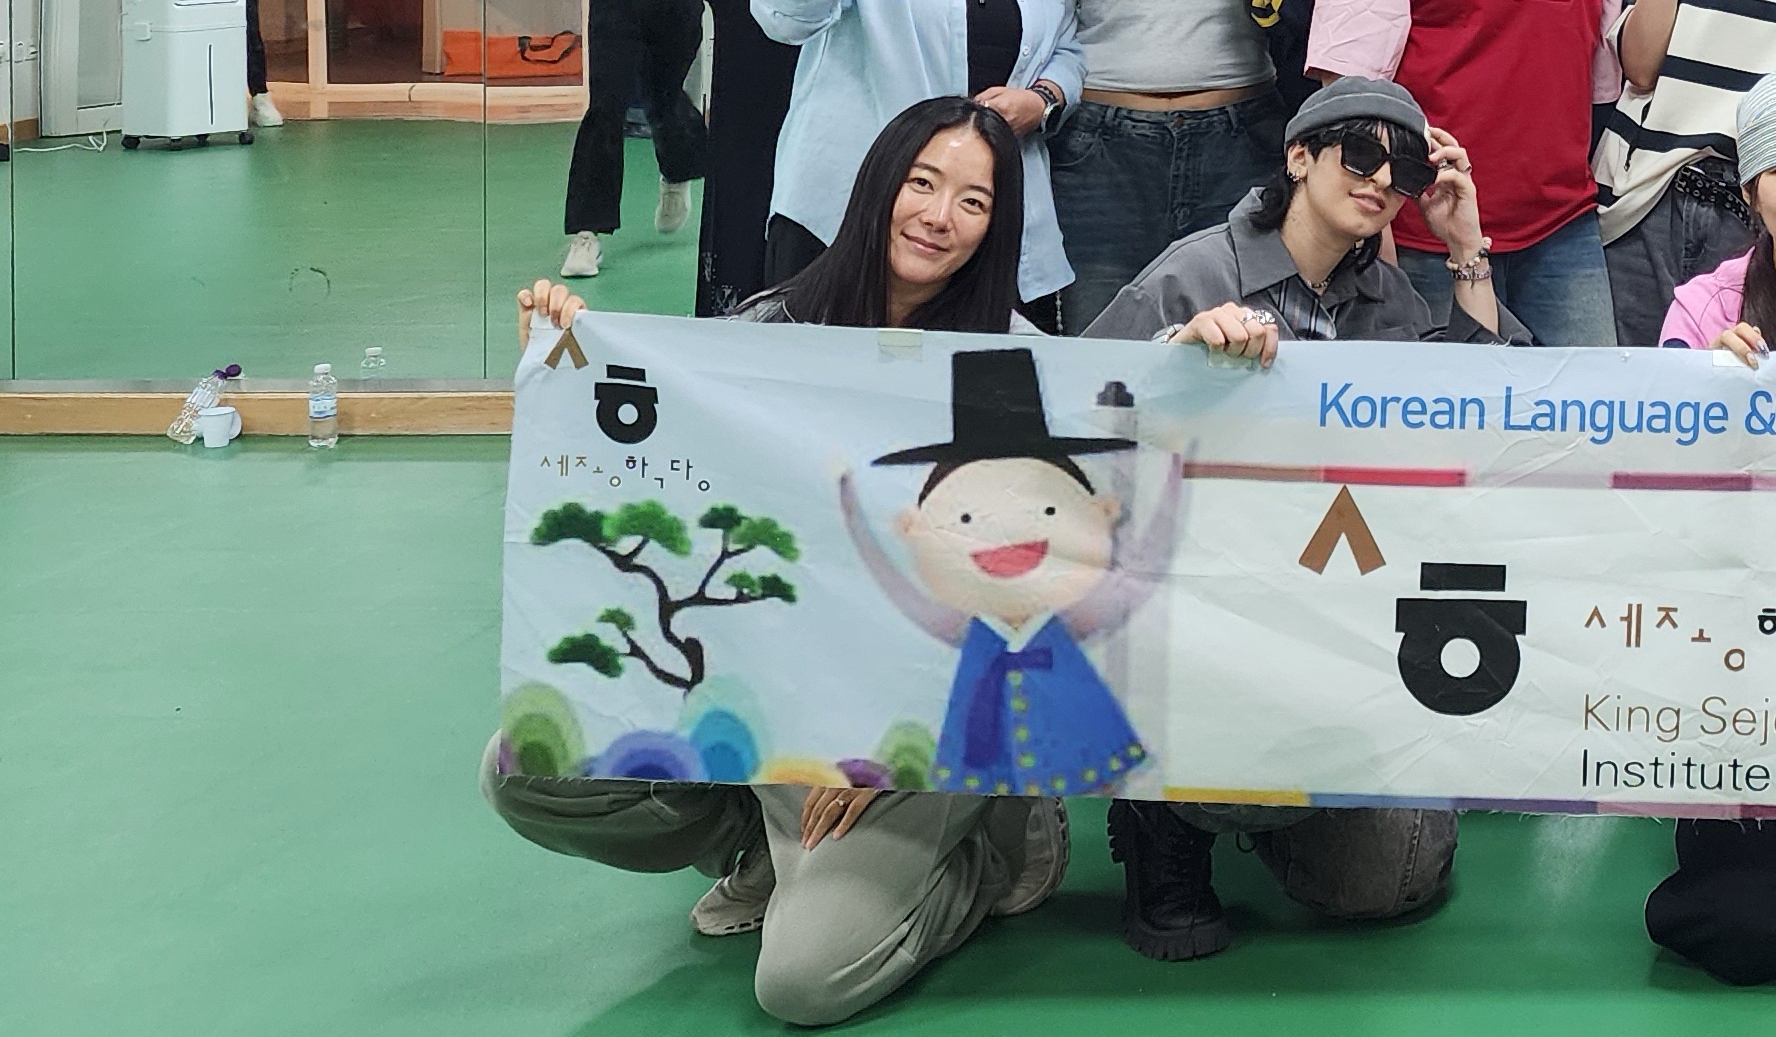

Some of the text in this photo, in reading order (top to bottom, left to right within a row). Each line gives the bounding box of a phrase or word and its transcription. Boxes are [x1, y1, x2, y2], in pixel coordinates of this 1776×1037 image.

[1318, 382, 1486, 432] Korean
[1503, 385, 1730, 445] Language
[1744, 391, 1776, 436] &
[540, 454, 710, 492] 세종학당
[1583, 694, 1682, 741] King
[1581, 749, 1770, 792] Institute
